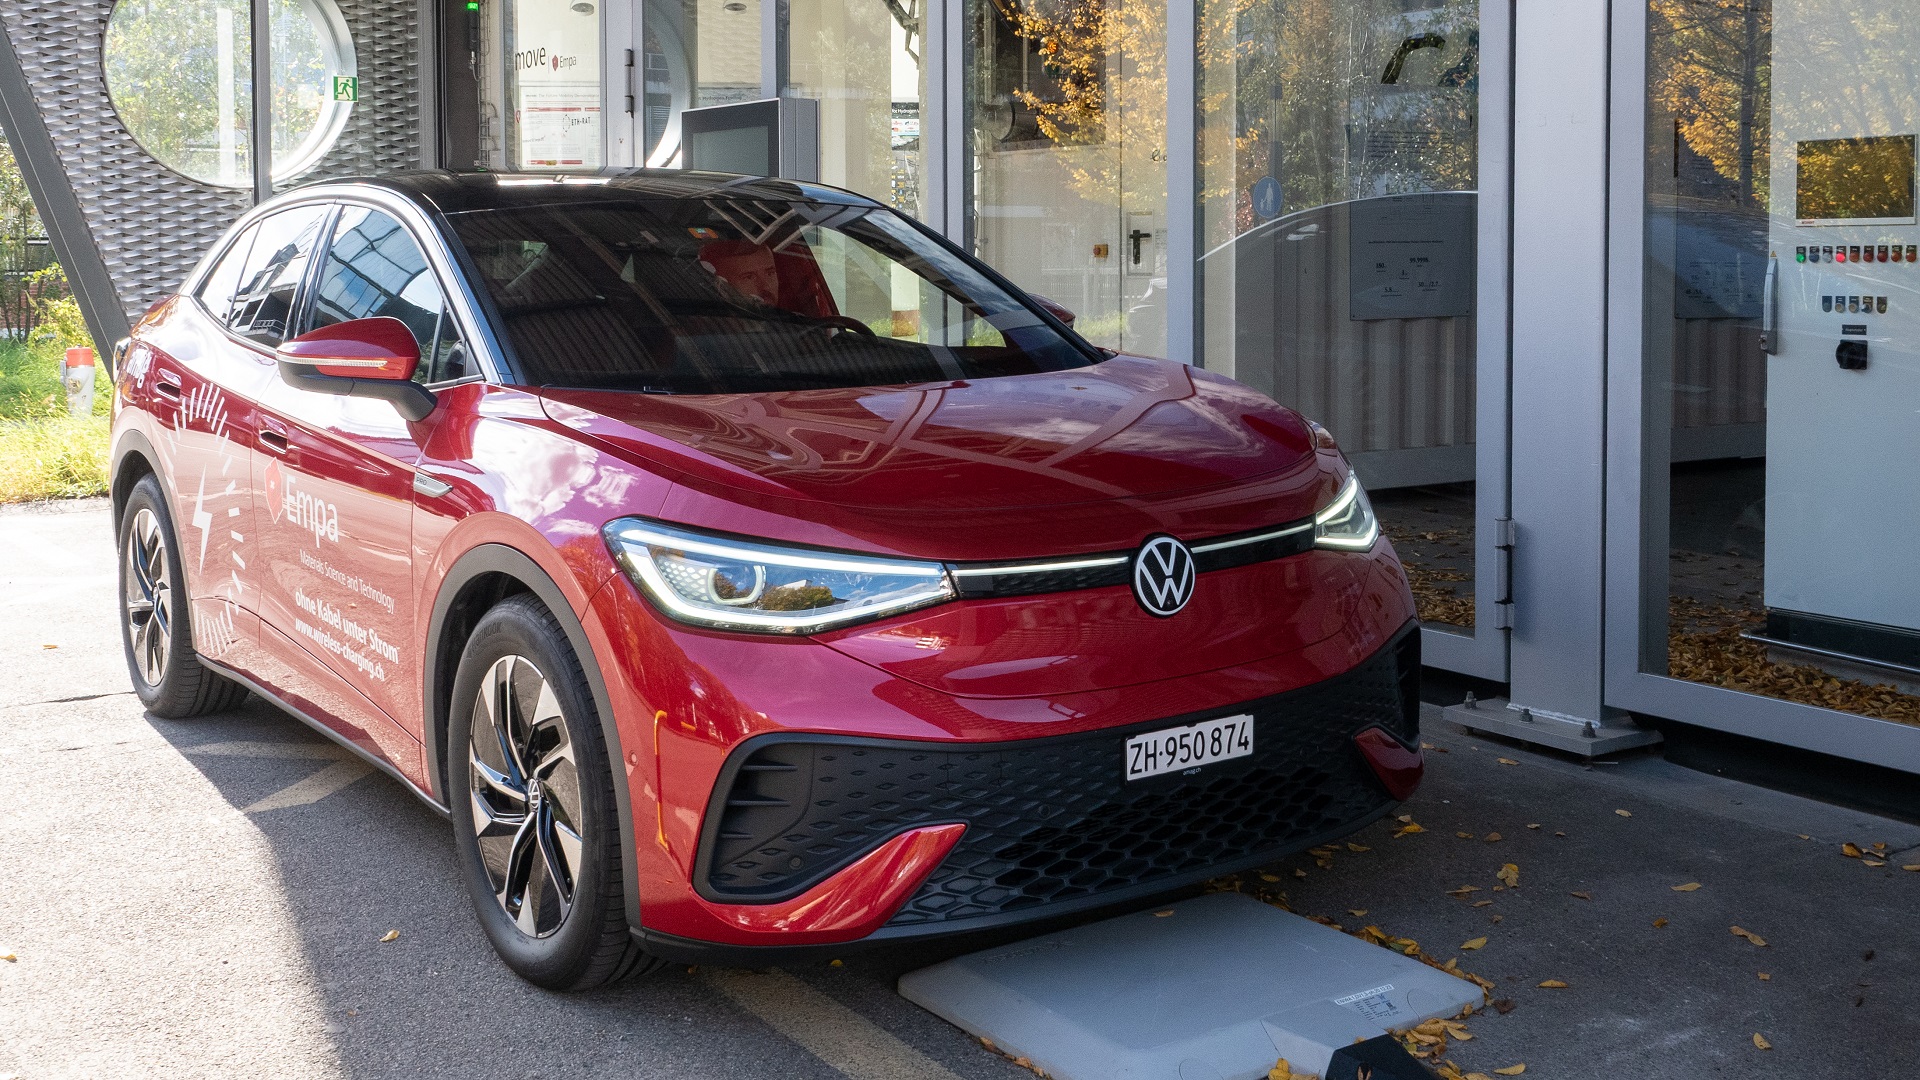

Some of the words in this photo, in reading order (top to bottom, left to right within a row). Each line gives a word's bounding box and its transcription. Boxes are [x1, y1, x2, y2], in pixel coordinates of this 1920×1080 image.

[514, 47, 546, 71] move
[560, 56, 576, 70] Empa
[416, 476, 428, 486] PRO
[286, 474, 339, 548] Empa
[299, 548, 325, 575] Materials
[324, 561, 346, 586] Science
[346, 575, 359, 592] and
[358, 578, 395, 614] Technology
[295, 587, 317, 616] ohne
[316, 598, 342, 631] Kabel
[342, 618, 368, 645] unter
[368, 628, 399, 664] Strom
[295, 618, 385, 682] www.wireless-charging.ch
[1182, 767, 1202, 776] amag.ch
